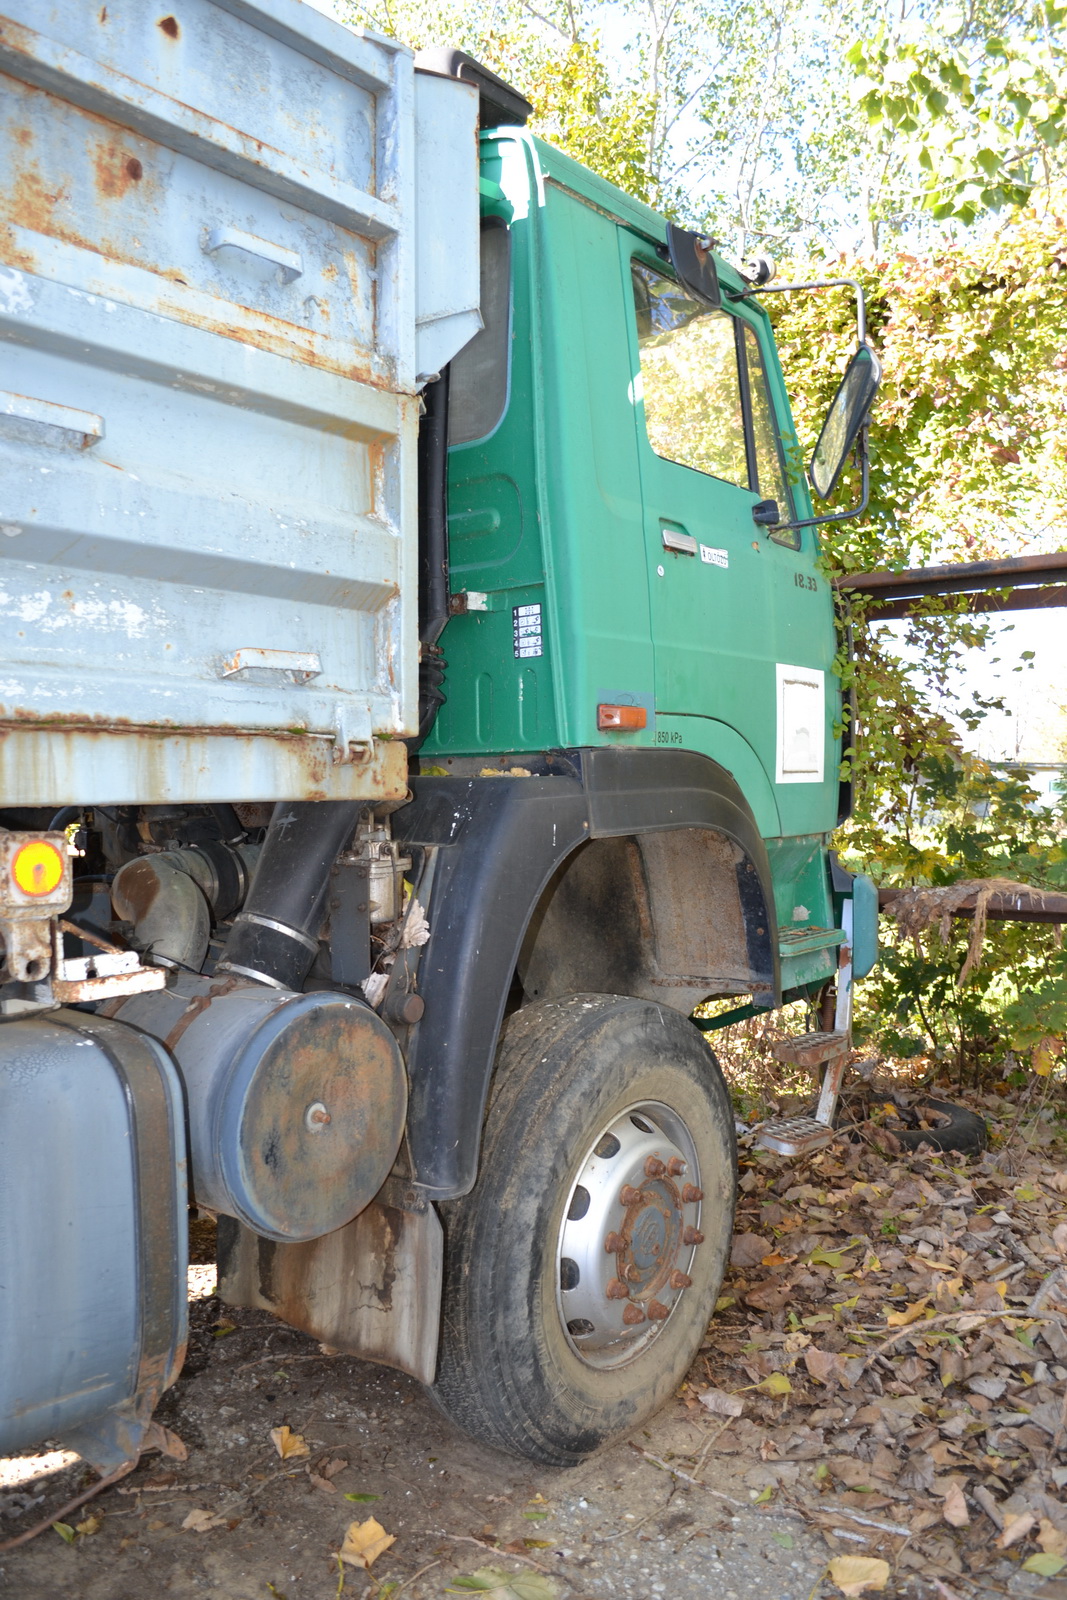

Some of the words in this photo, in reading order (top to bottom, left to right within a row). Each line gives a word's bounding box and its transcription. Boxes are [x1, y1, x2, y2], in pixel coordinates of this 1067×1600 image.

[794, 572, 817, 592] 18.33
[657, 731, 669, 743] 850
[670, 731, 683, 744] kPa
